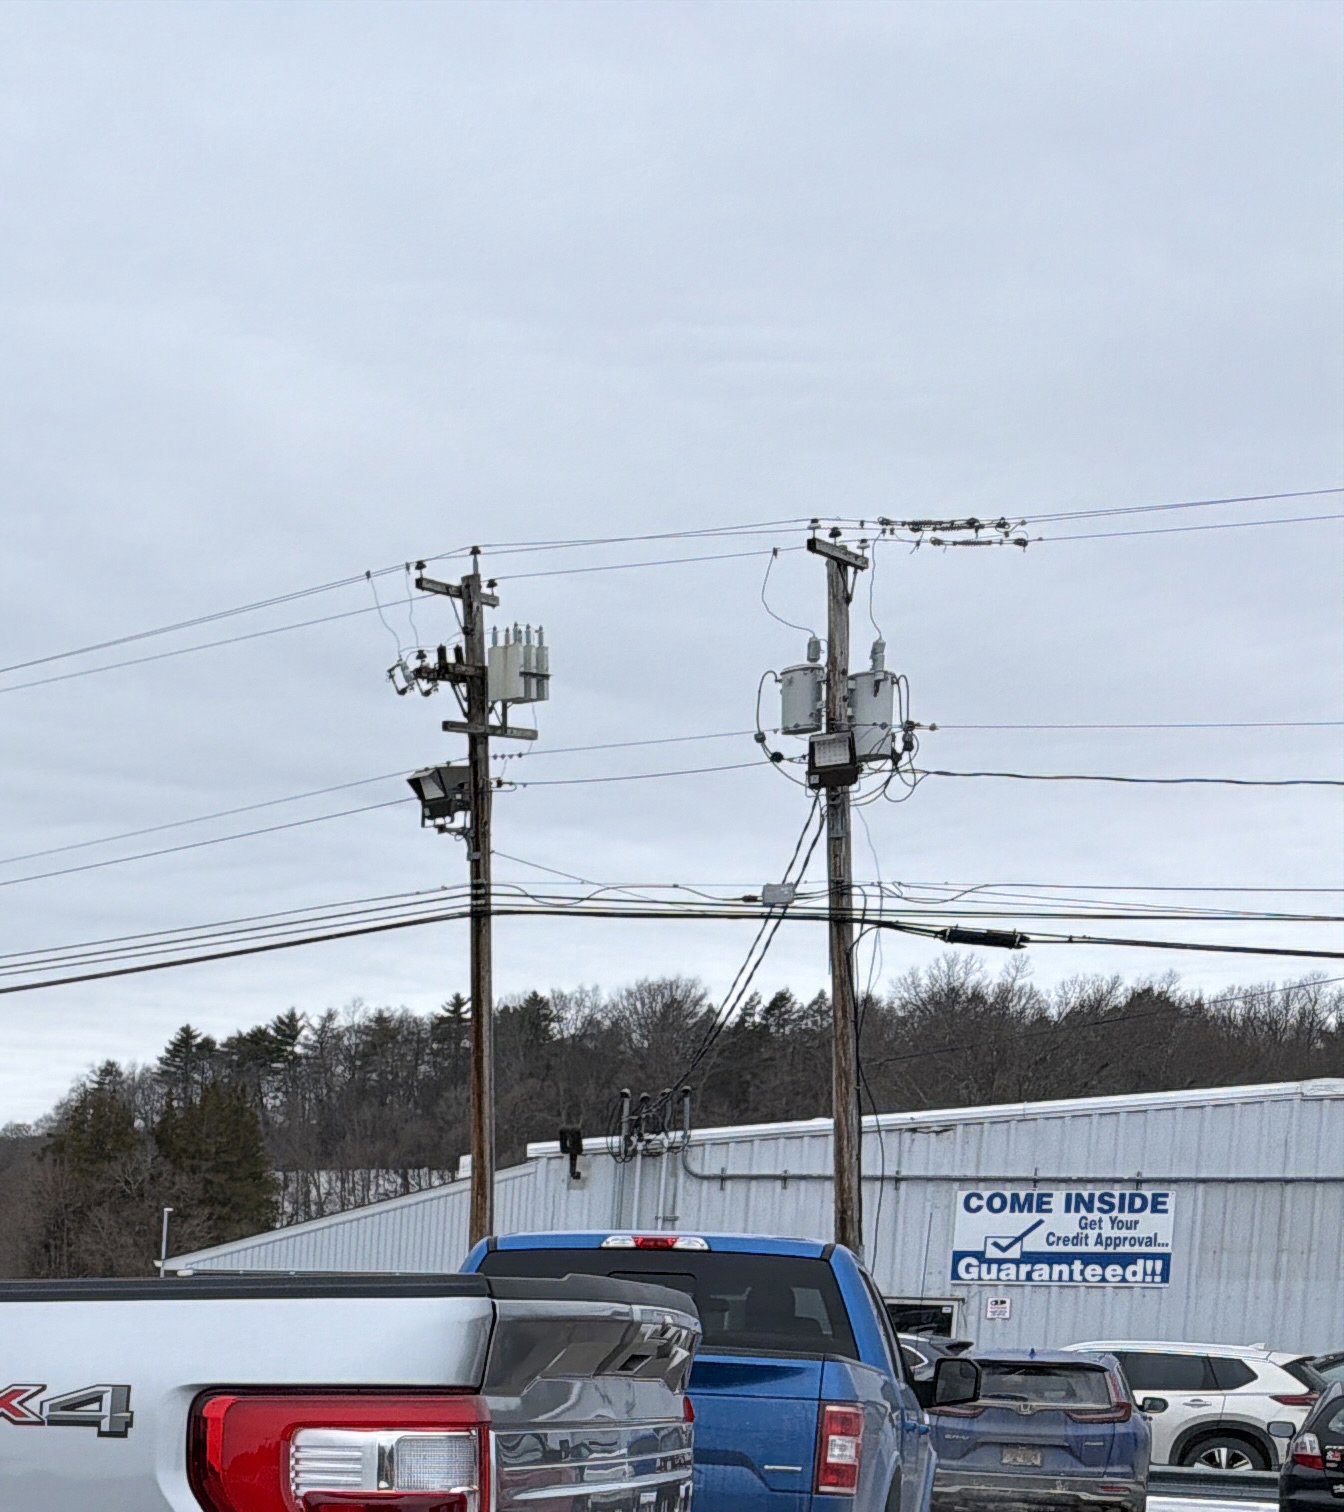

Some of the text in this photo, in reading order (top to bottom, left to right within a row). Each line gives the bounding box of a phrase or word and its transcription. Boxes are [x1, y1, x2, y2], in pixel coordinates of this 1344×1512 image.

[963, 1192, 1169, 1214] COME INSIDE
[1078, 1216, 1140, 1231] Get Your
[1045, 1232, 1170, 1250] Credit Approval...
[957, 1256, 1163, 1283] Guaranteed!!
